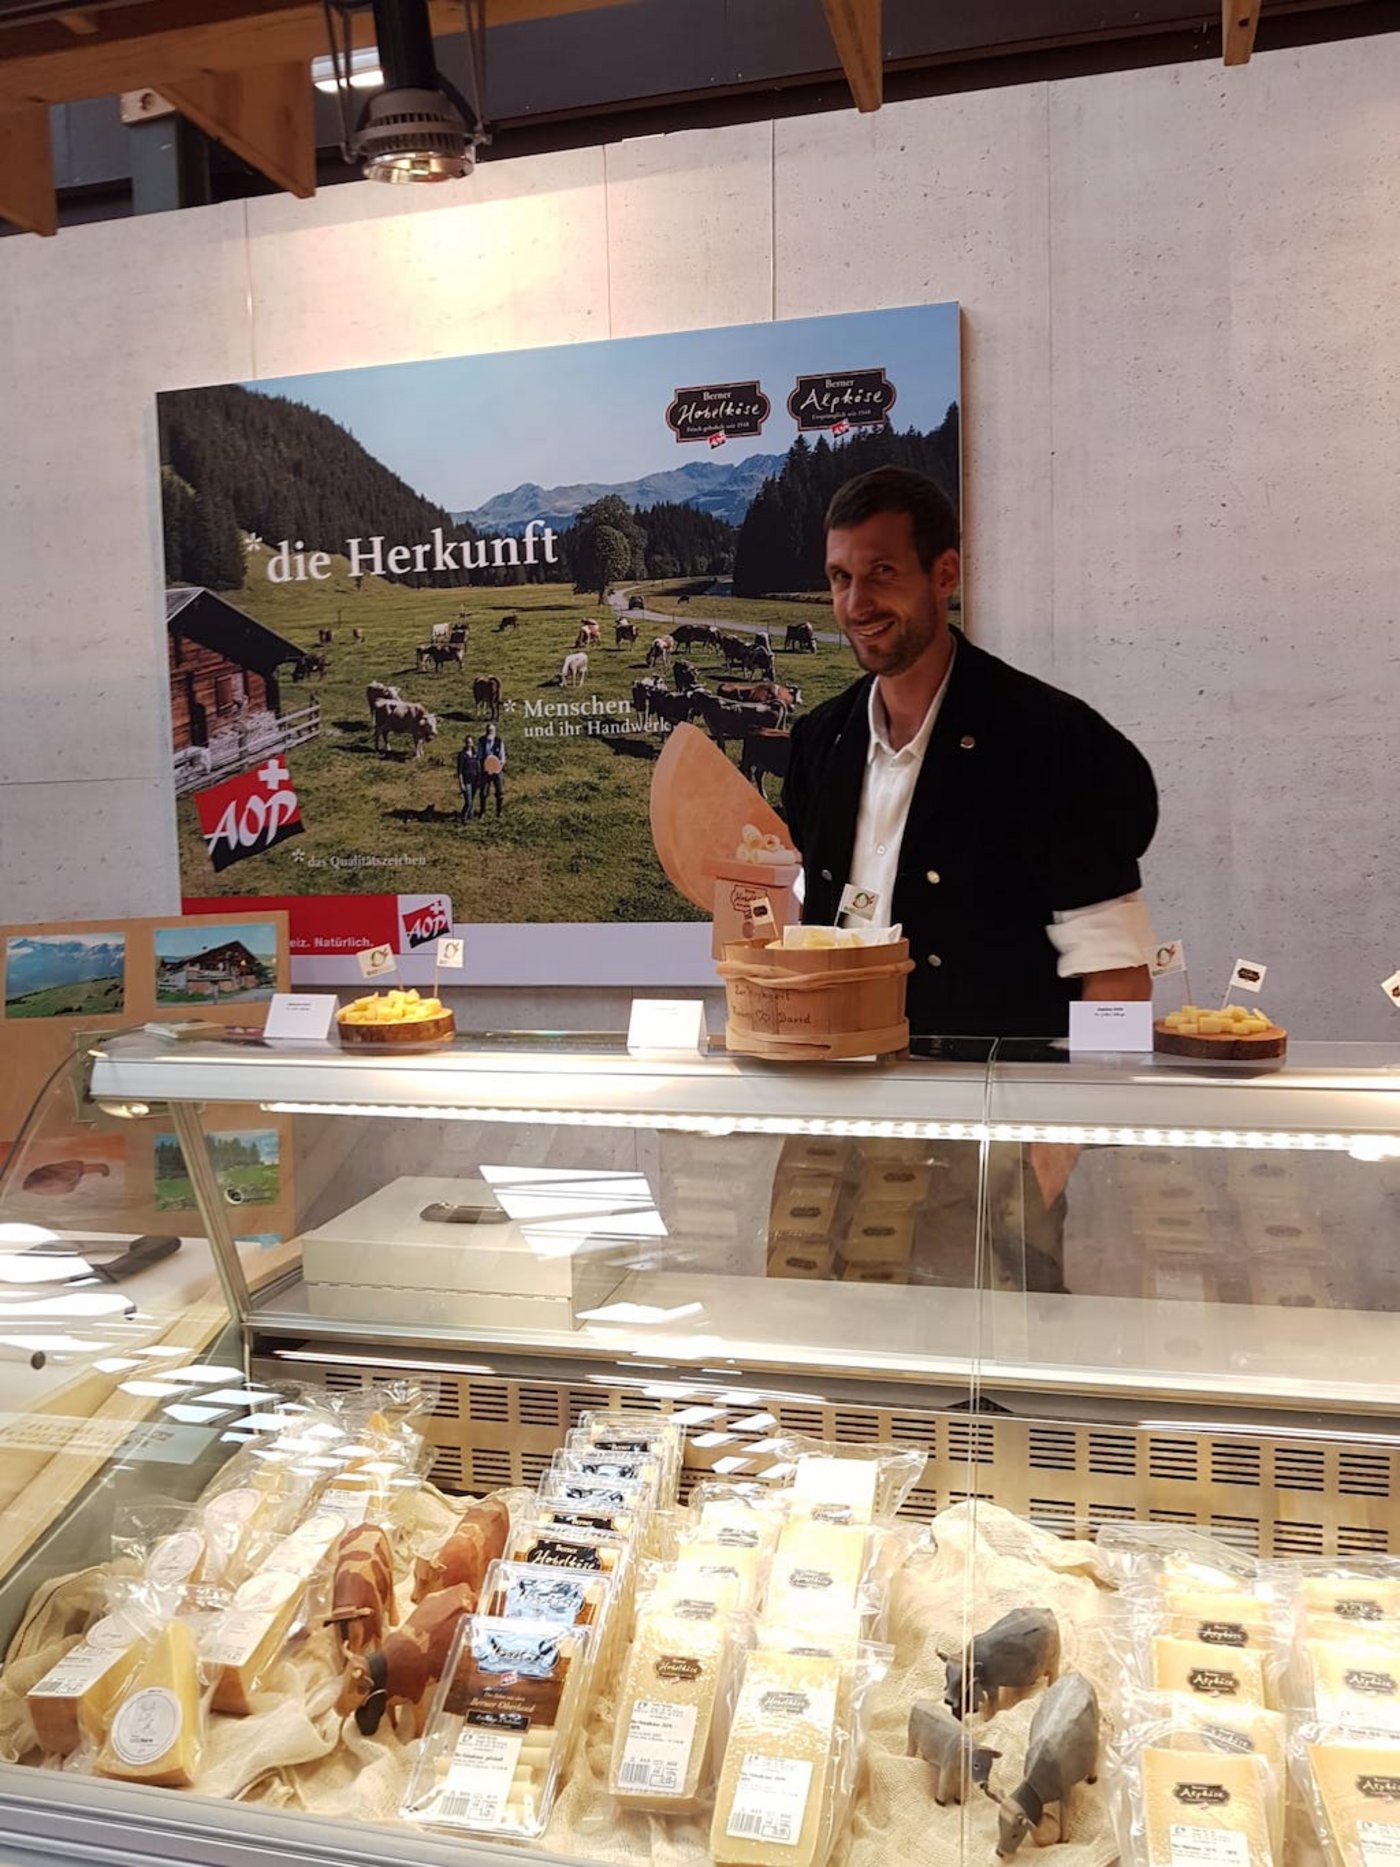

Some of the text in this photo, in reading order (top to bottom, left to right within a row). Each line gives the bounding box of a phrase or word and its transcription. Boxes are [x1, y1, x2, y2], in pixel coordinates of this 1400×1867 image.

[825, 379, 855, 388] Berner
[703, 391, 732, 401] Berner
[800, 387, 884, 414] Alpkäse
[677, 401, 760, 426] Hobelkäse
[266, 519, 559, 583] die Herkunft
[523, 695, 632, 718] Menschen
[523, 719, 554, 738] und
[559, 721, 582, 737] ihr
[204, 790, 298, 855] AOP
[307, 854, 426, 868] das Qualitätszeichen
[407, 914, 446, 939] AOP
[314, 936, 375, 948] Natürlich.
